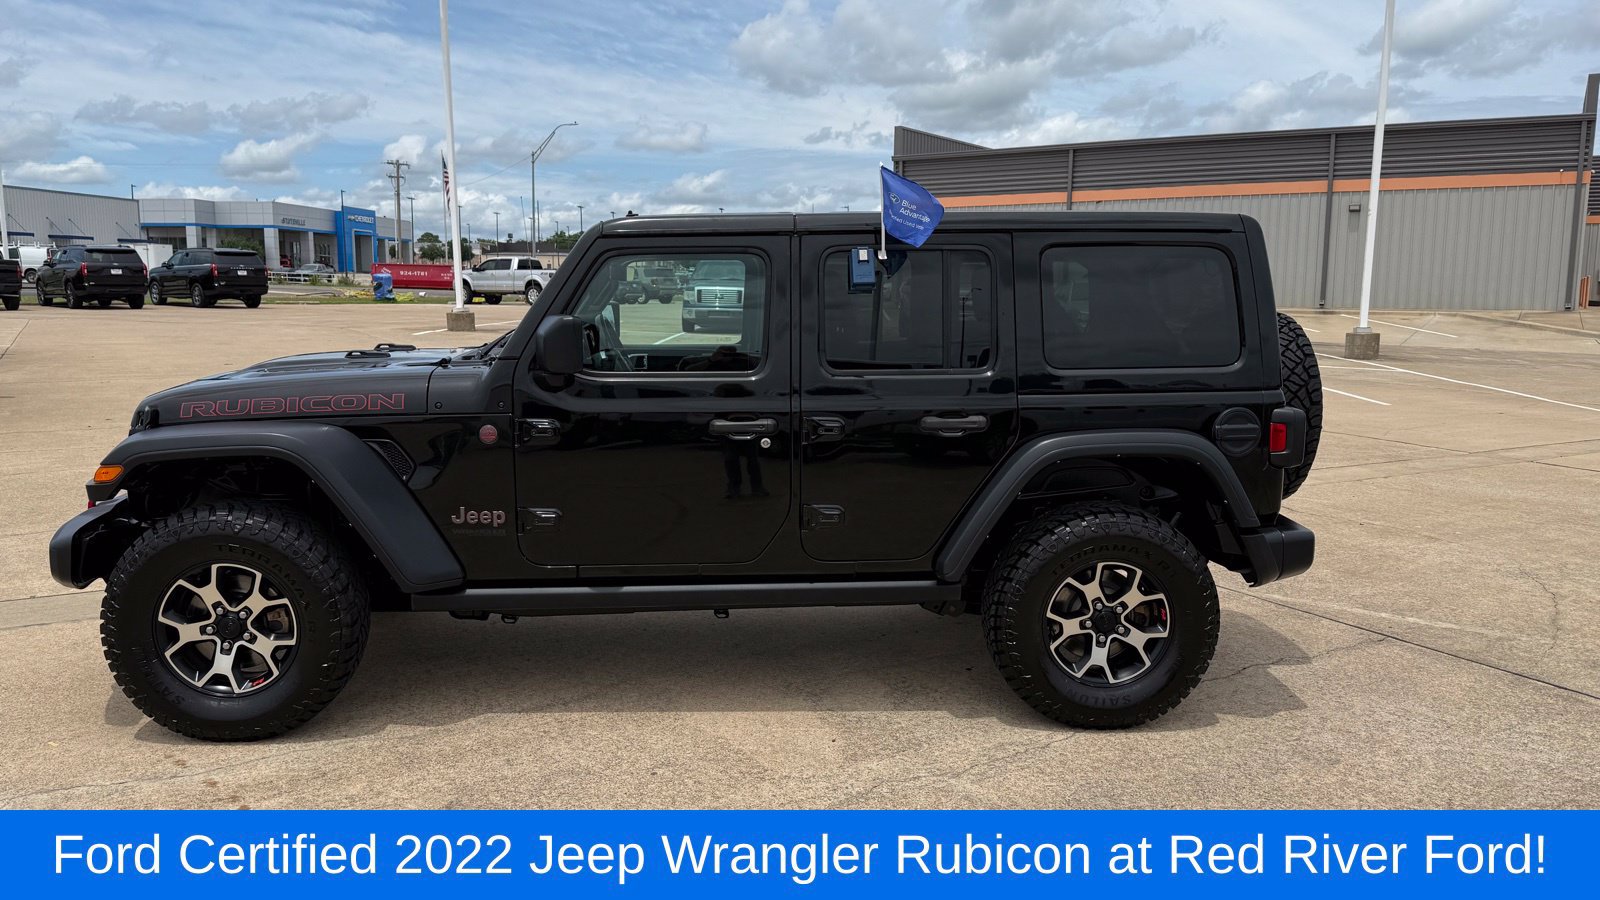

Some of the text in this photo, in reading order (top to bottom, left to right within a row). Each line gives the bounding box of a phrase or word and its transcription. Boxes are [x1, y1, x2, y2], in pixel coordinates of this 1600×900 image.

[902, 200, 917, 210] Blue
[179, 393, 405, 418] RUBICON
[451, 506, 506, 528] Jeep
